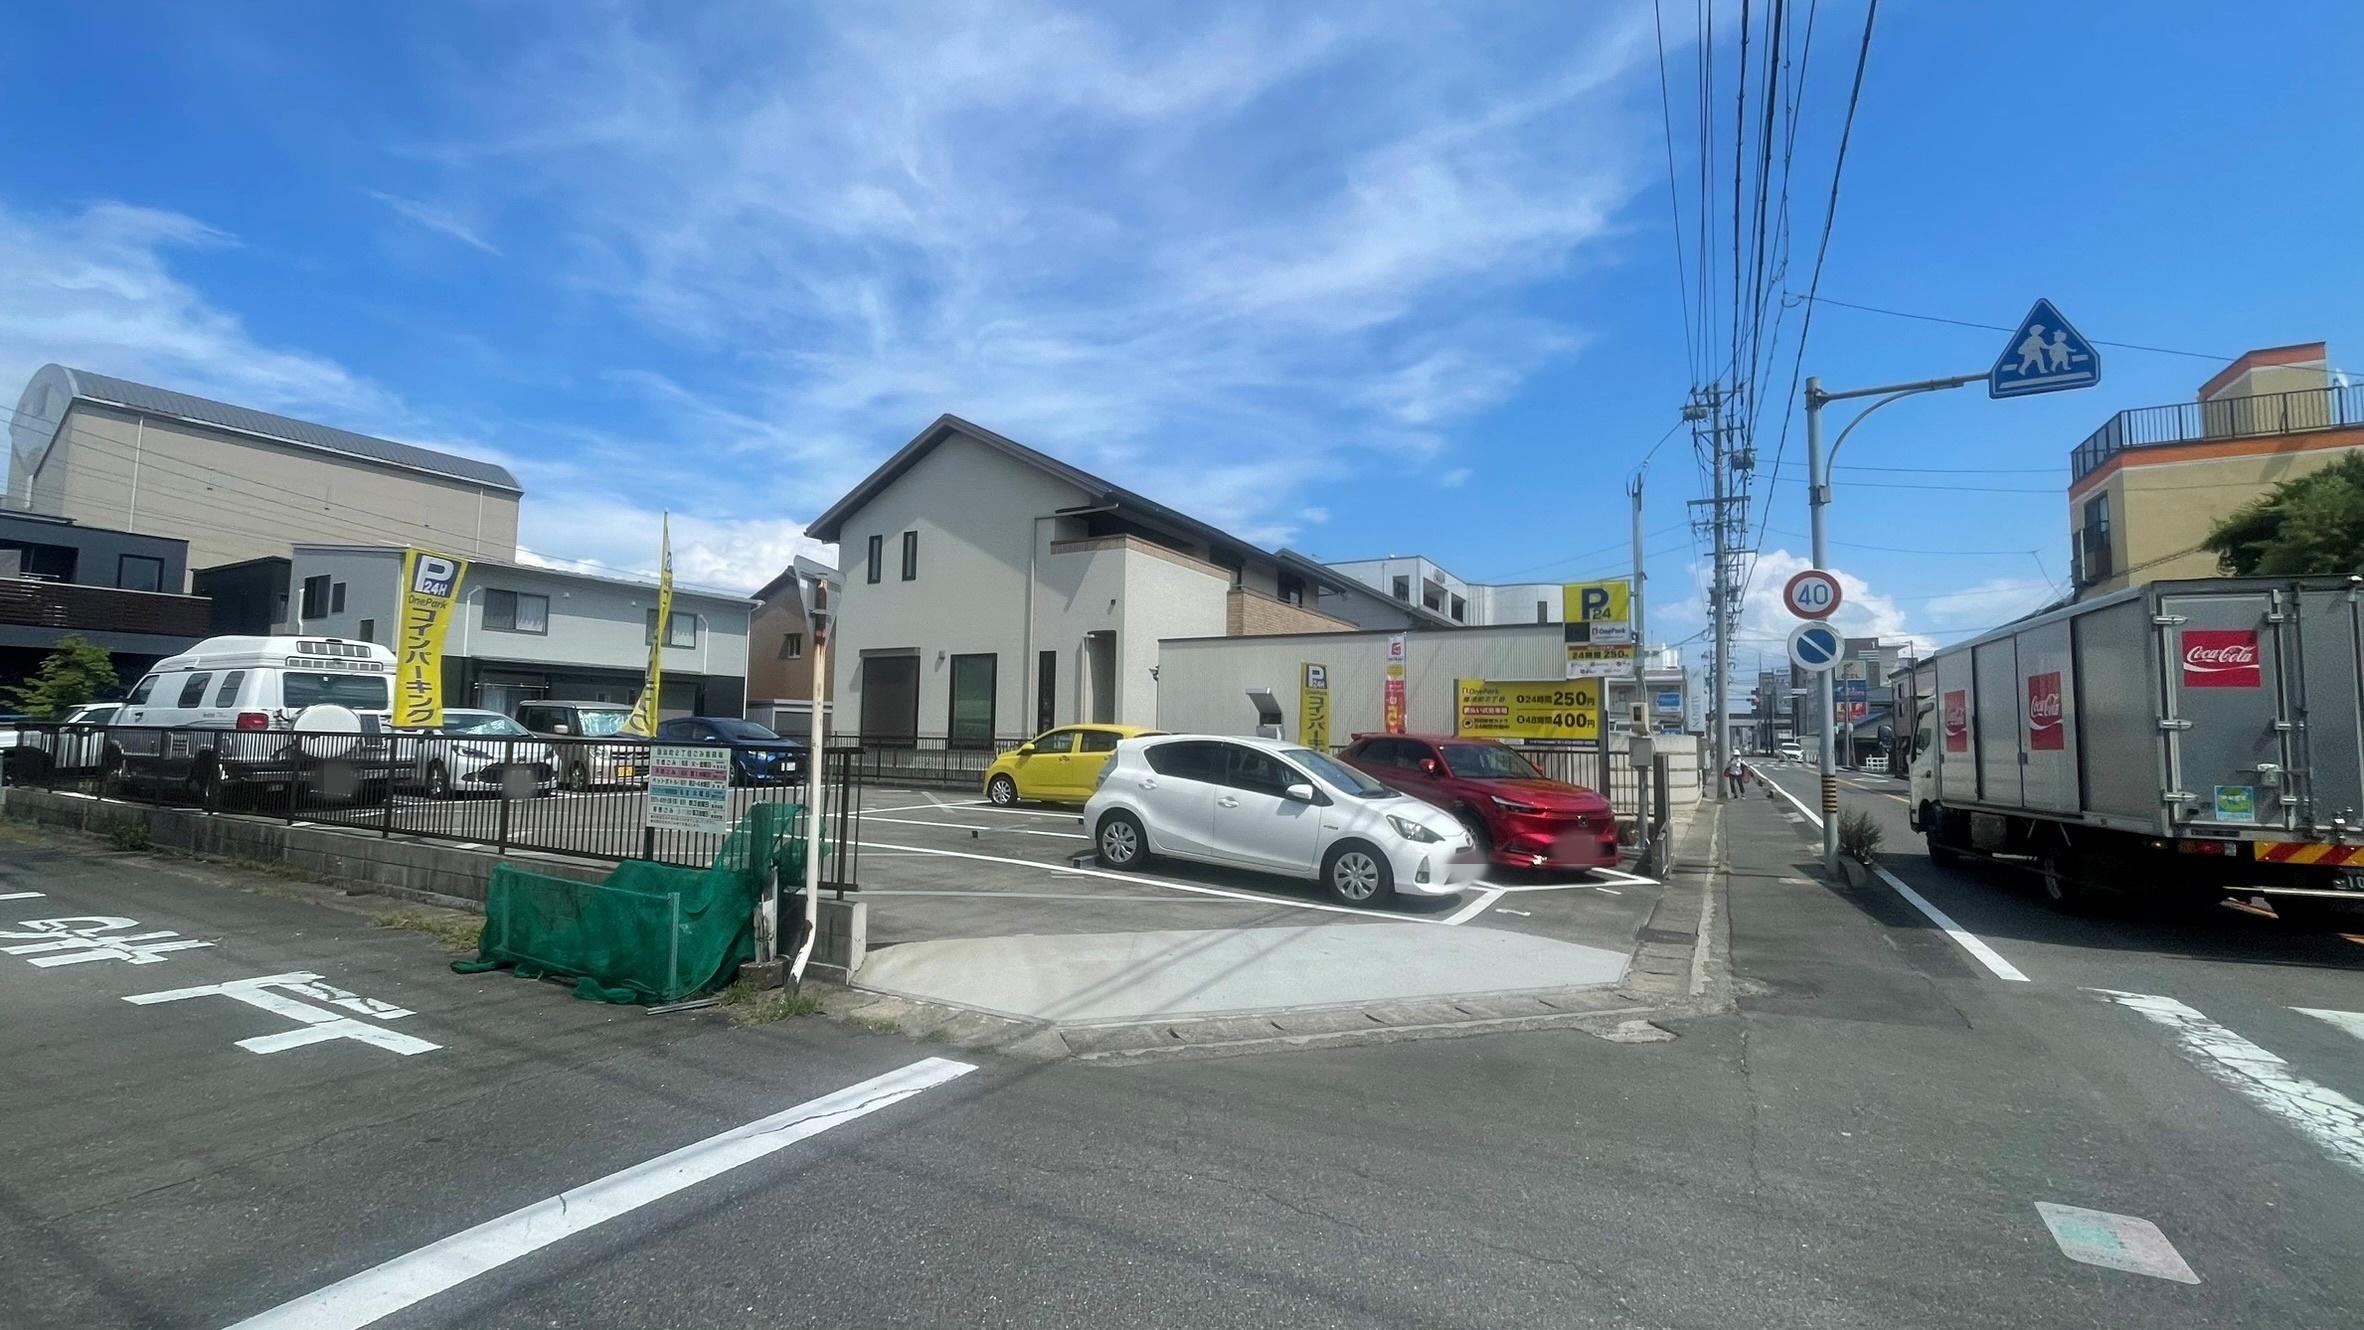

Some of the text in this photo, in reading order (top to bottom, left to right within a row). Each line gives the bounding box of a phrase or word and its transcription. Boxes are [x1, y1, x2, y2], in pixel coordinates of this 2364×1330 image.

[413, 555, 455, 592] P
[424, 581, 448, 596] 24H
[1797, 584, 1828, 605] 40
[408, 594, 448, 609] OnePark
[1582, 588, 1609, 620] P
[1593, 608, 1611, 620] 24
[405, 607, 437, 723] コインパーキング
